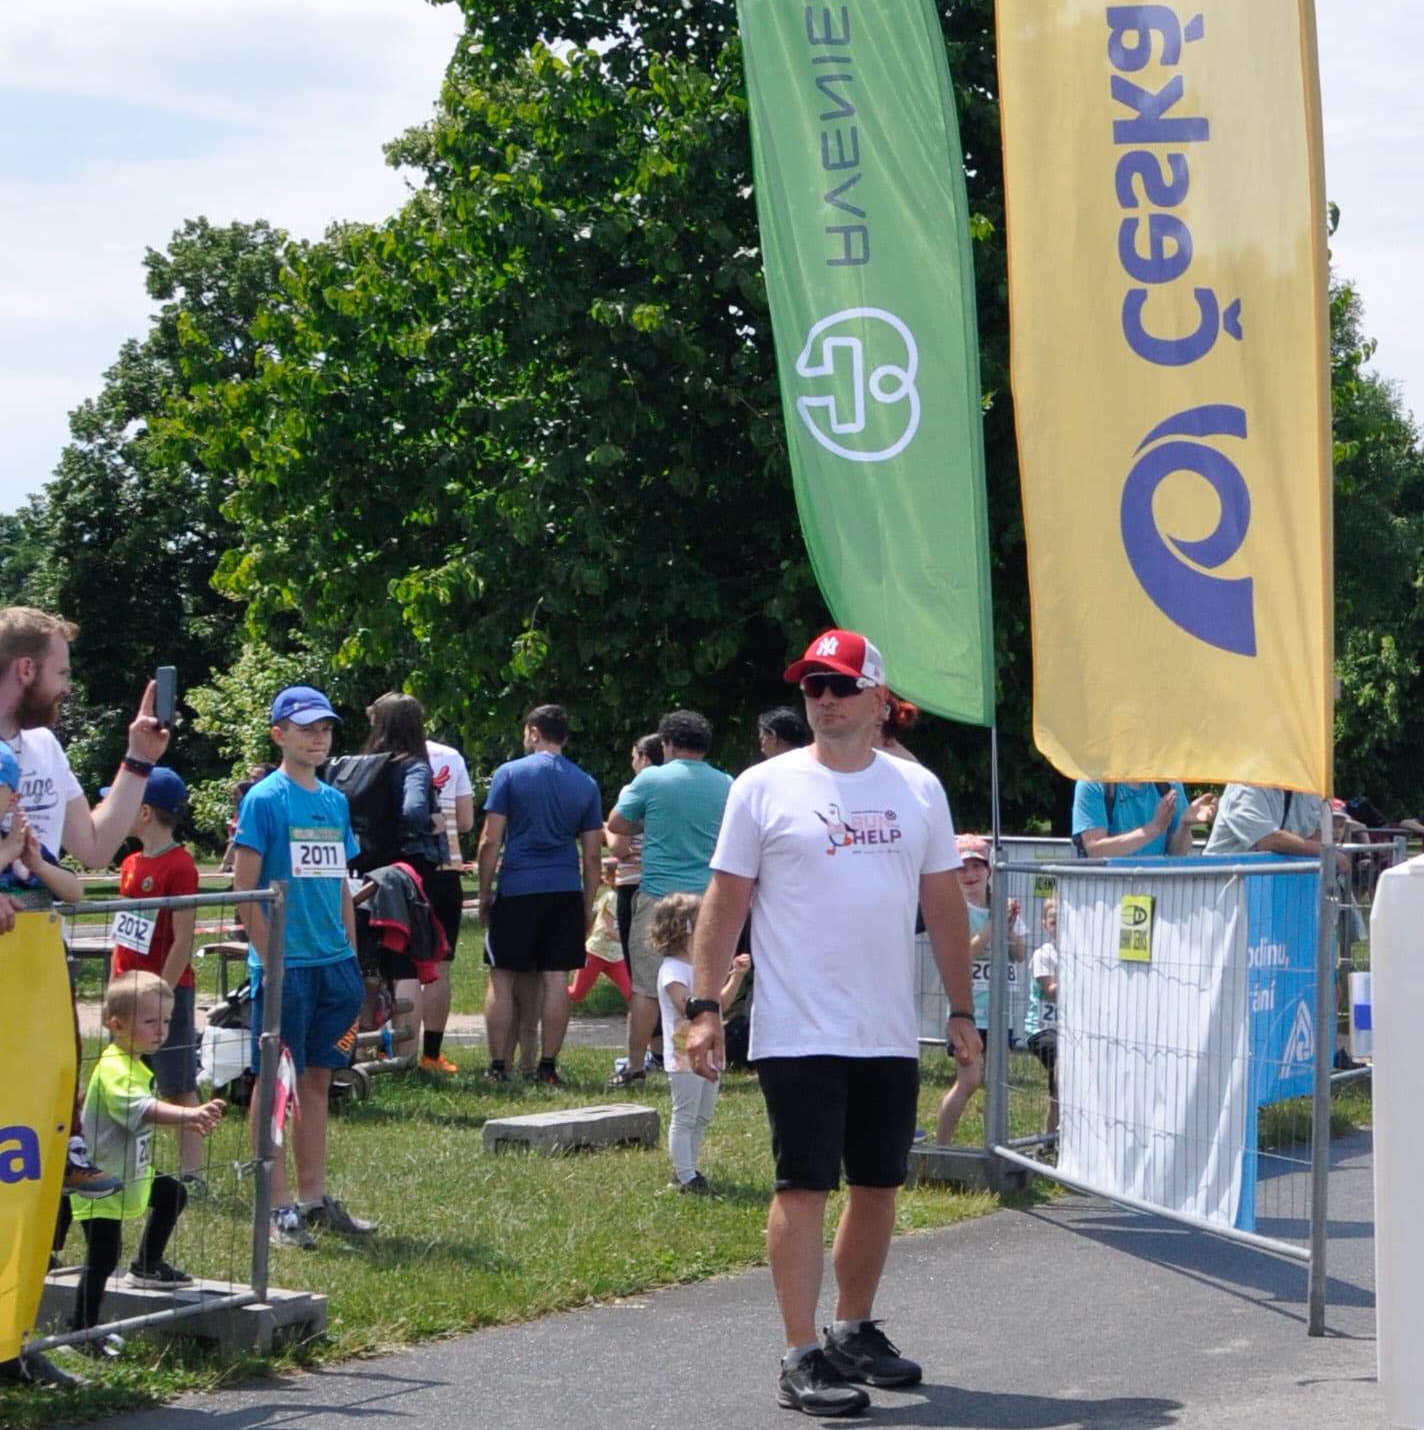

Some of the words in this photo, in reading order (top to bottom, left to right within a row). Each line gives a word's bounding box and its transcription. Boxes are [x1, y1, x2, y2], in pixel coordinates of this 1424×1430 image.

[853, 829, 902, 845] HELP
[301, 845, 338, 865] 2011
[117, 914, 149, 941] 2012
